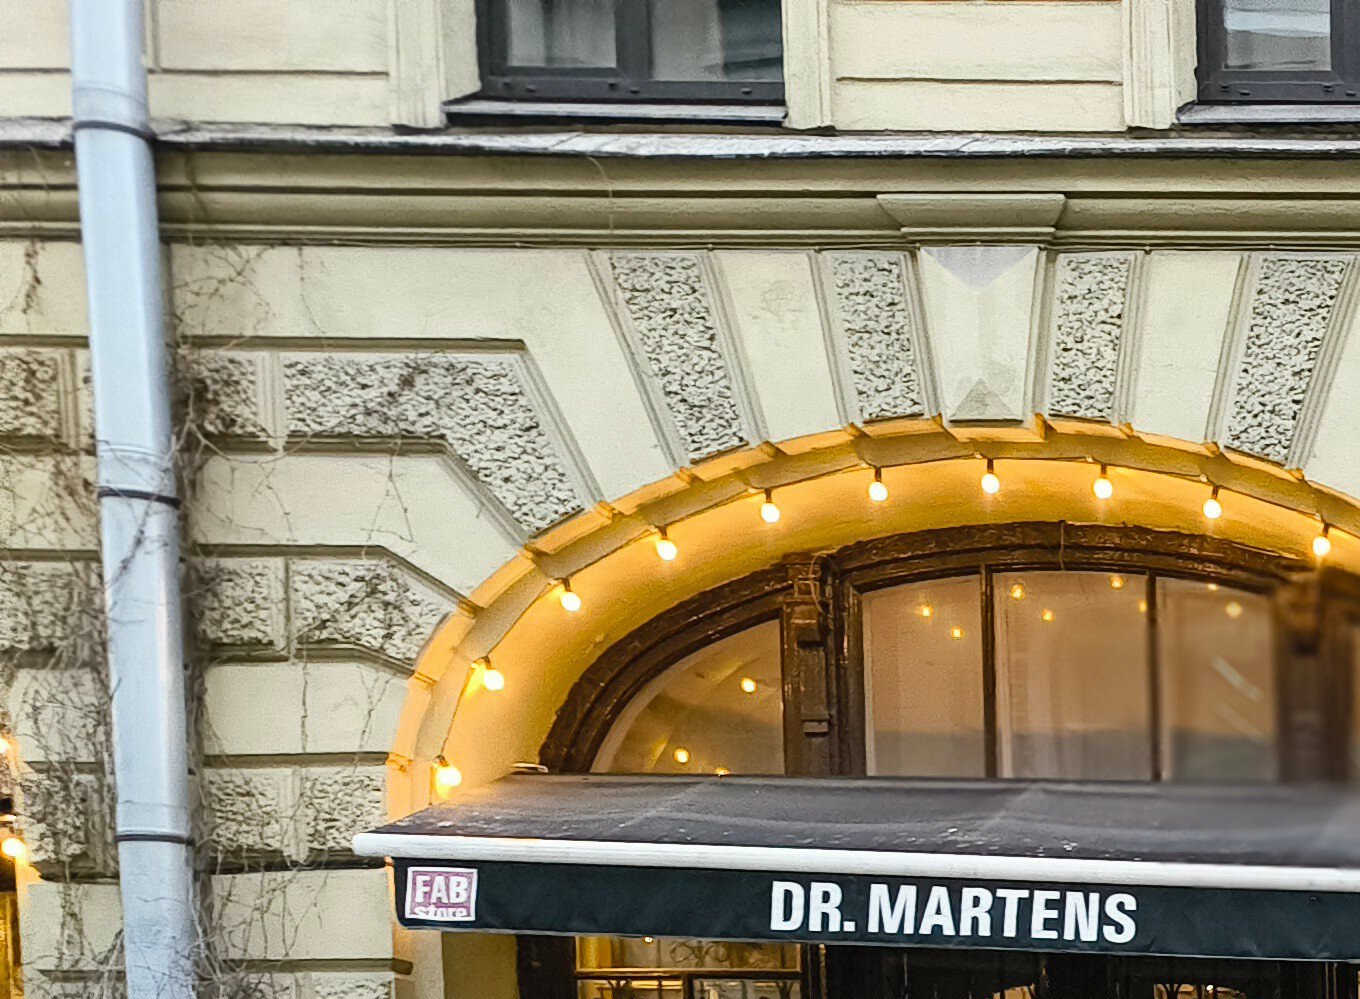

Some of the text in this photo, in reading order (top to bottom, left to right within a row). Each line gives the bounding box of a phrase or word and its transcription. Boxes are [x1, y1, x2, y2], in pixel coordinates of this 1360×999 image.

[414, 875, 469, 904] FAB
[413, 903, 467, 918] store
[770, 880, 1138, 943] DR. MARTENS
